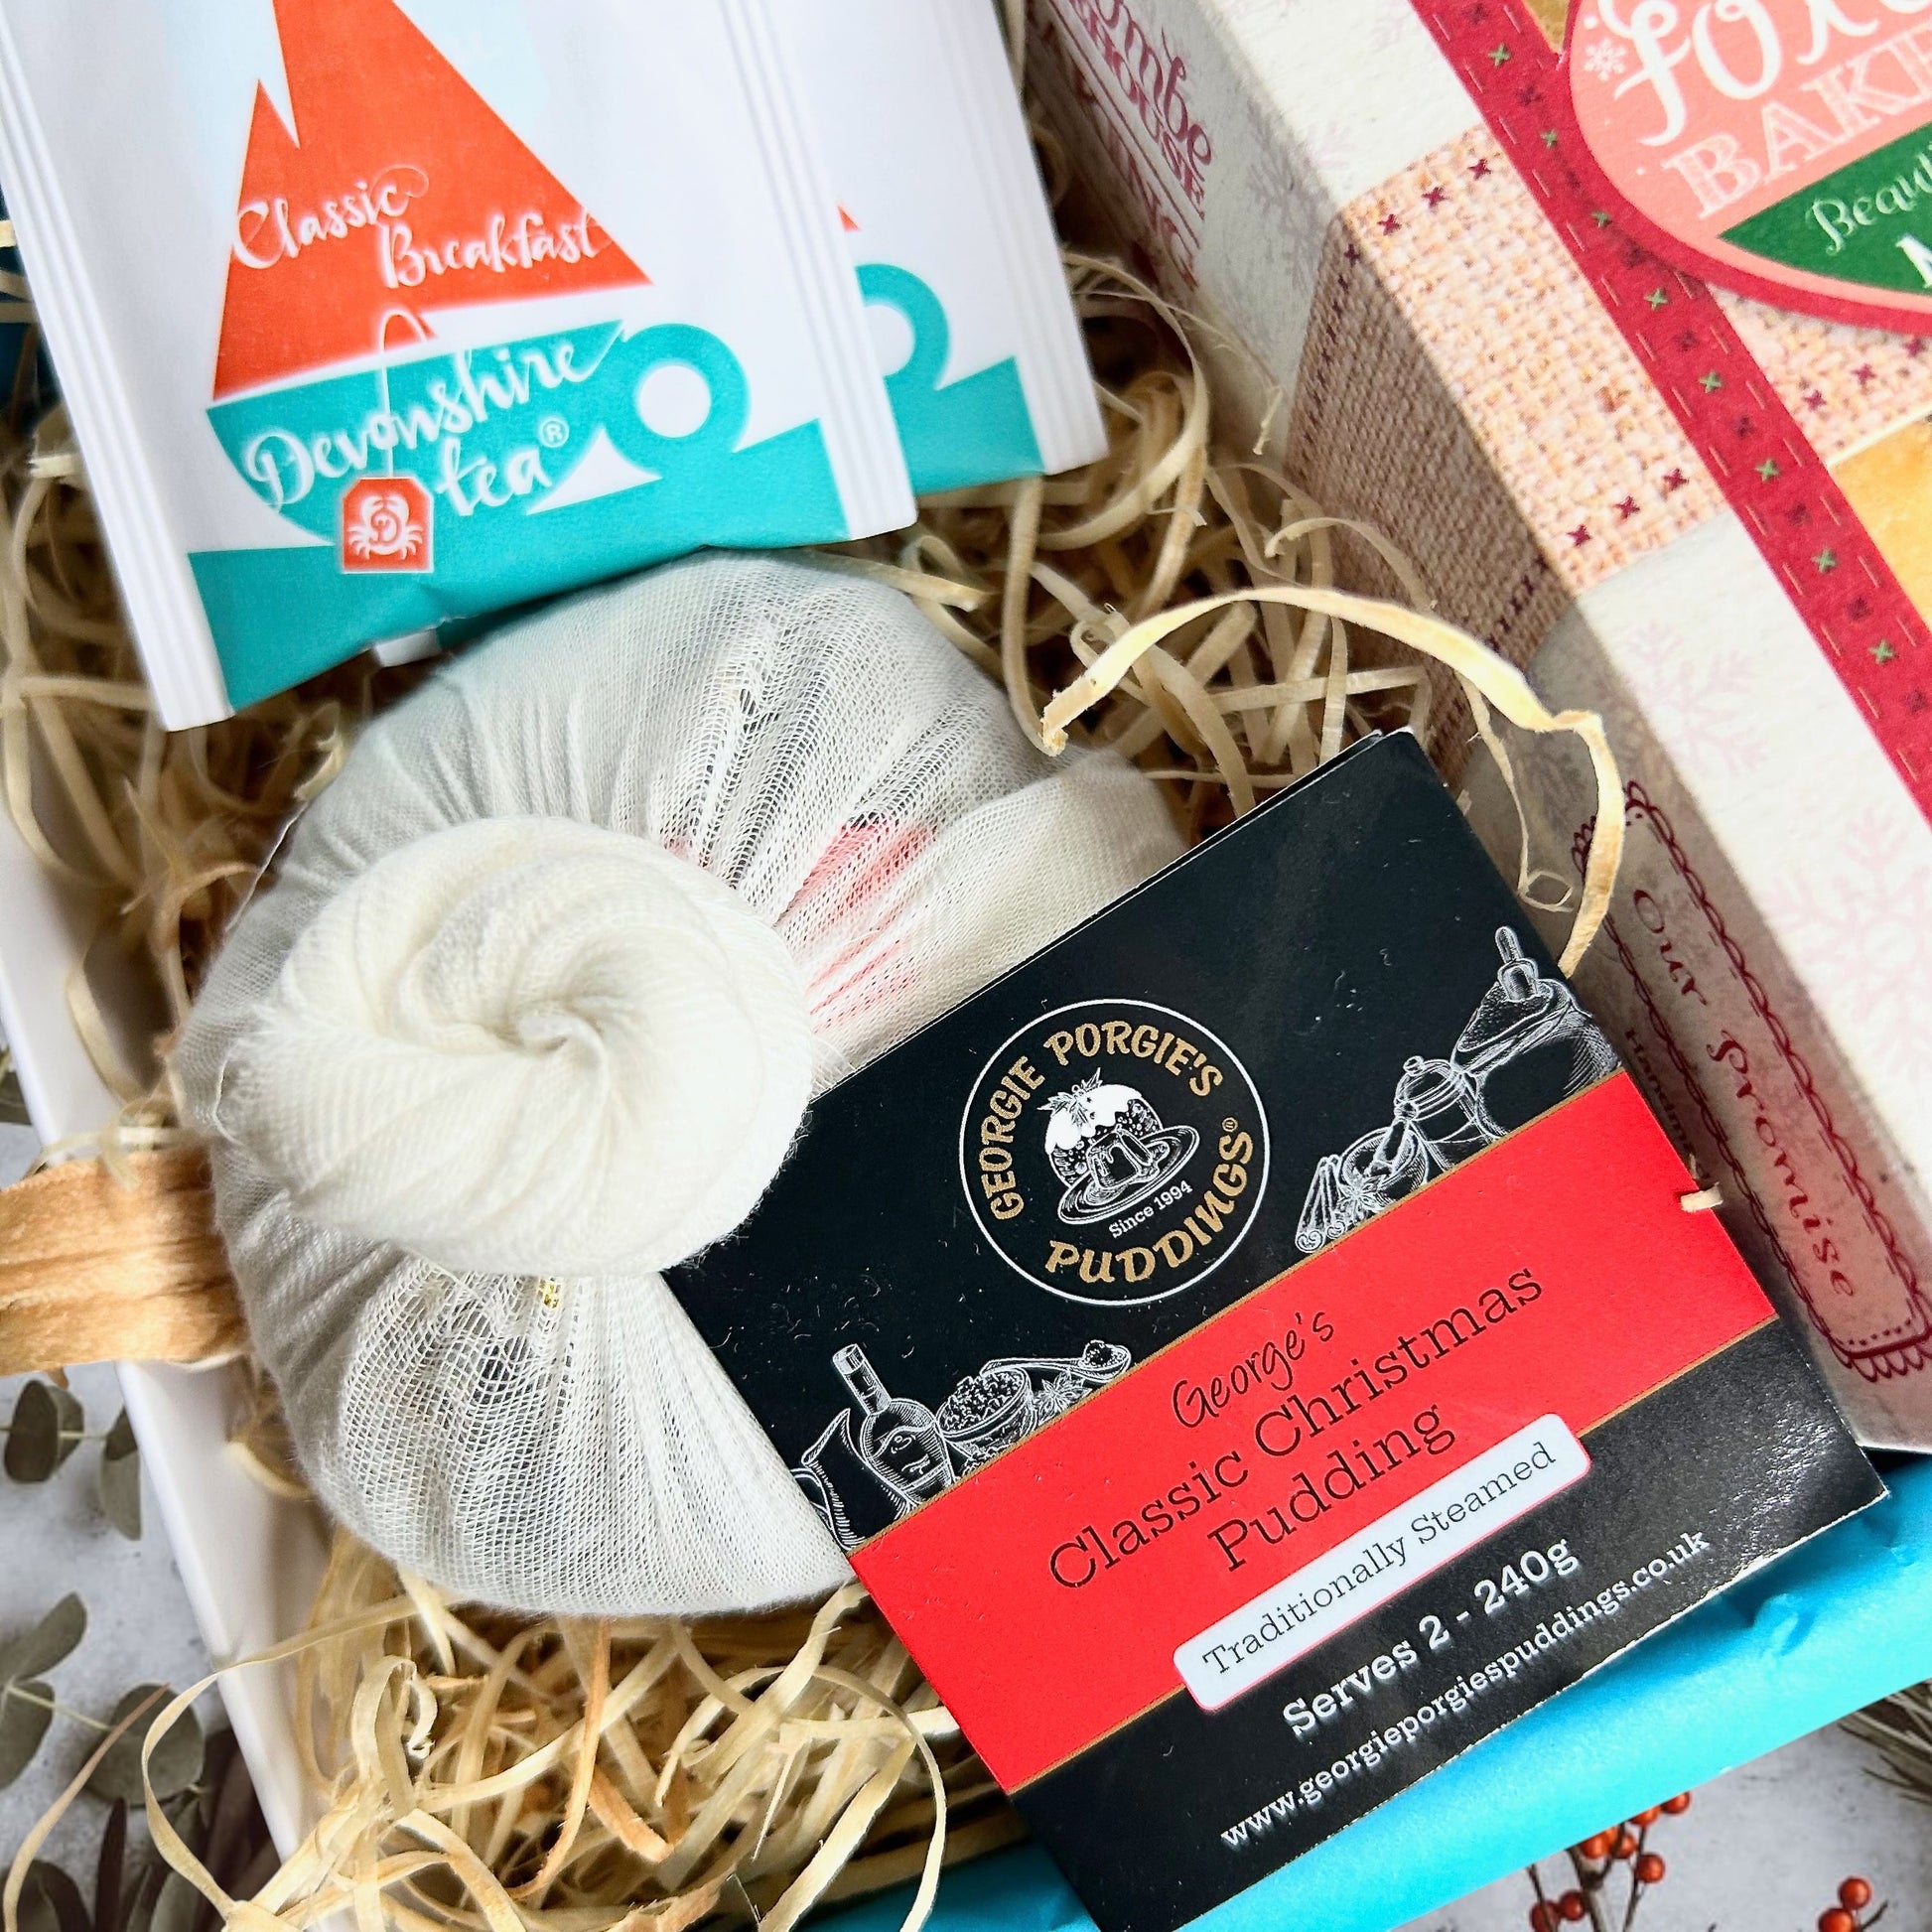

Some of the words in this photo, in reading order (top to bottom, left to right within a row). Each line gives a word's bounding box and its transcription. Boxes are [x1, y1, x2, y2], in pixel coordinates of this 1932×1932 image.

[1069, 0, 1205, 220] HOUSE
[1095, 0, 1212, 182] ombe
[232, 166, 428, 268] Classic
[377, 205, 606, 289] Breakfast
[244, 330, 620, 512] Devonshire
[1632, 889, 1708, 1006] Our
[979, 1055, 1045, 1220] GEORGIE
[1043, 1020, 1223, 1097] PORGIE'S
[1108, 1206, 1155, 1239] Since
[1153, 1178, 1193, 1210] 1994
[1707, 1030, 1855, 1299] Promise
[1049, 1451, 1249, 1588] Classic
[1255, 1268, 1542, 1456] Christmas
[1173, 1311, 1335, 1428] George's
[1201, 1536, 1408, 1675] Traditionally
[1411, 1441, 1557, 1545] Steamed
[1206, 1404, 1455, 1572] Pudding
[1220, 1529, 1710, 1848] www.georgieporgiespuddings.co.uk
[1283, 1639, 1418, 1737] Serves
[1419, 1614, 1450, 1650] 2
[1473, 1537, 1581, 1616] 240g
